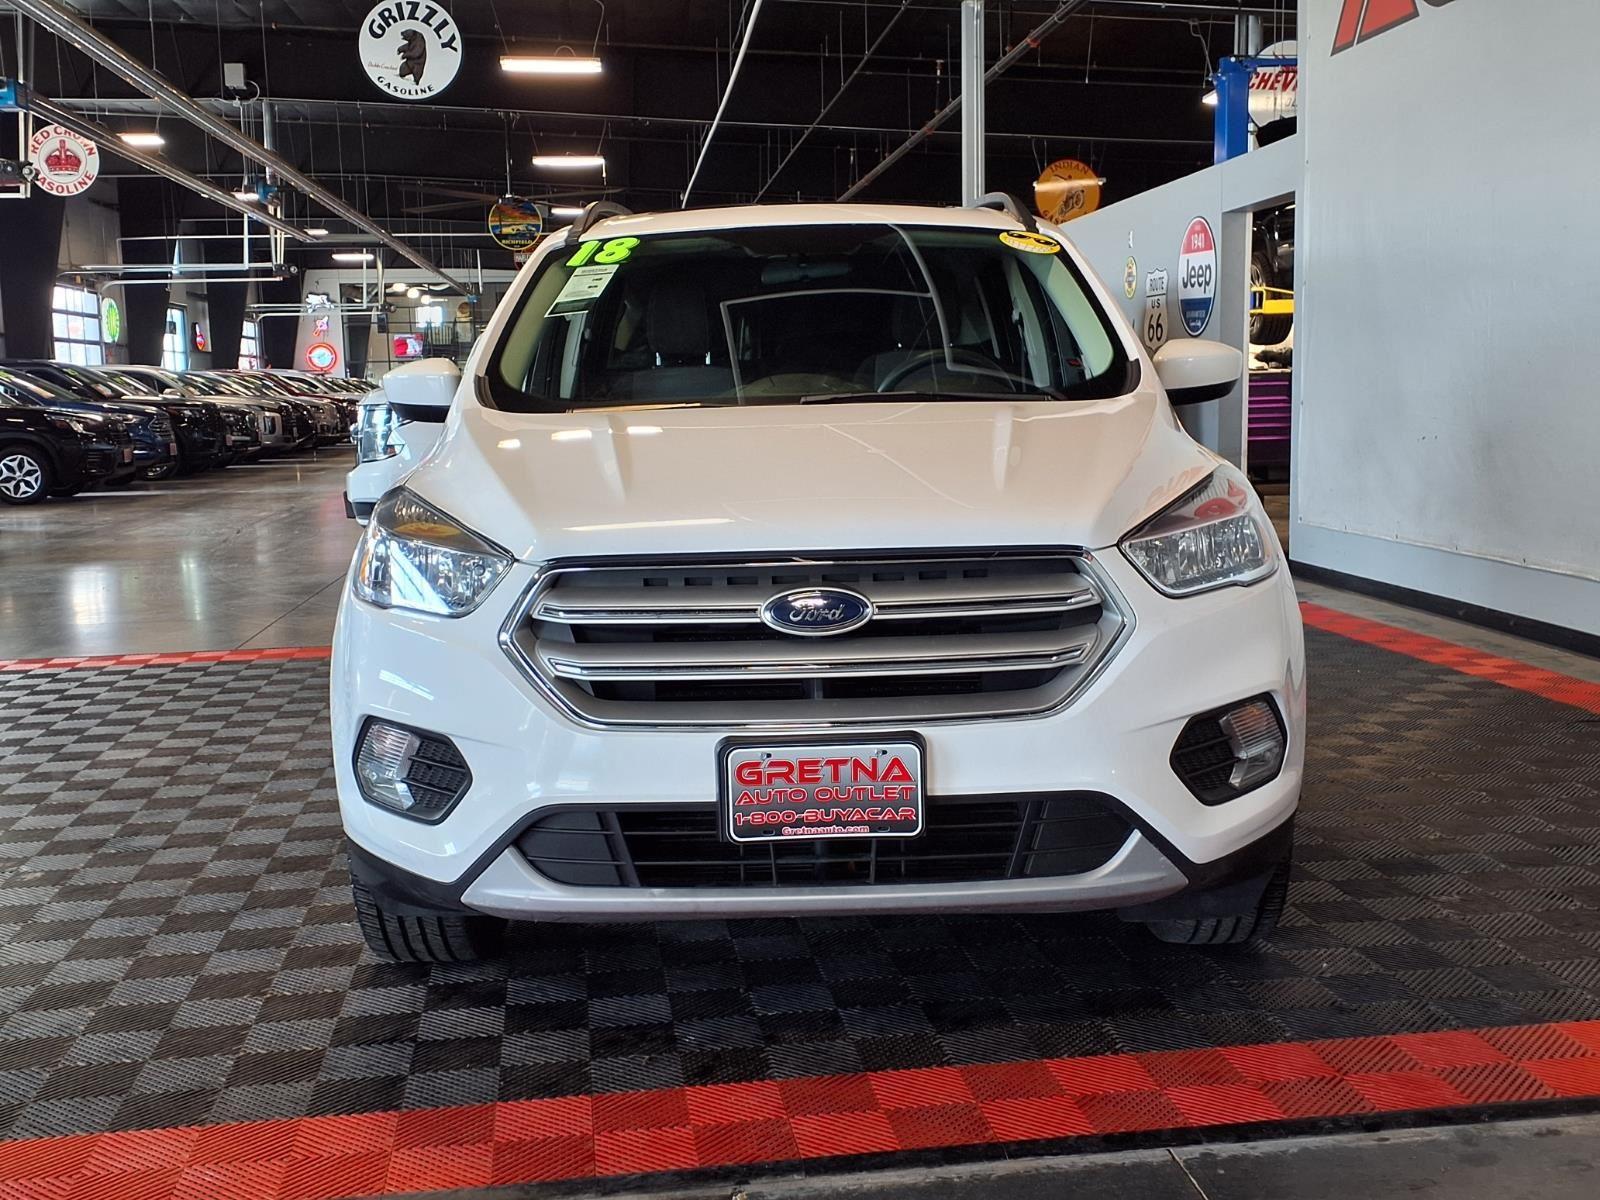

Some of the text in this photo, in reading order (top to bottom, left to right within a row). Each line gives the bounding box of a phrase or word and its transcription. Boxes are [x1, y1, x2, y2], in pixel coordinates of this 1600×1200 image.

[368, 0, 458, 53] GRIZZLY
[377, 76, 435, 96] GASOLINE
[1248, 71, 1297, 92] CHEV
[31, 129, 50, 155] RED
[1050, 161, 1089, 175] INDIAN
[36, 168, 95, 194] ASOLINE
[1191, 232, 1205, 249] 1941
[565, 237, 641, 267] 18
[1149, 276, 1165, 292] ROUTE
[1182, 258, 1212, 294] Jeep
[1151, 298, 1161, 309] US
[1147, 313, 1164, 343] 66
[789, 602, 846, 622] Ford
[734, 756, 916, 787] GRETNA
[735, 785, 917, 806] AUTO OUTLET
[734, 807, 917, 827] 1-800-BUYACAR
[781, 825, 870, 836] Gretnaauto.com
